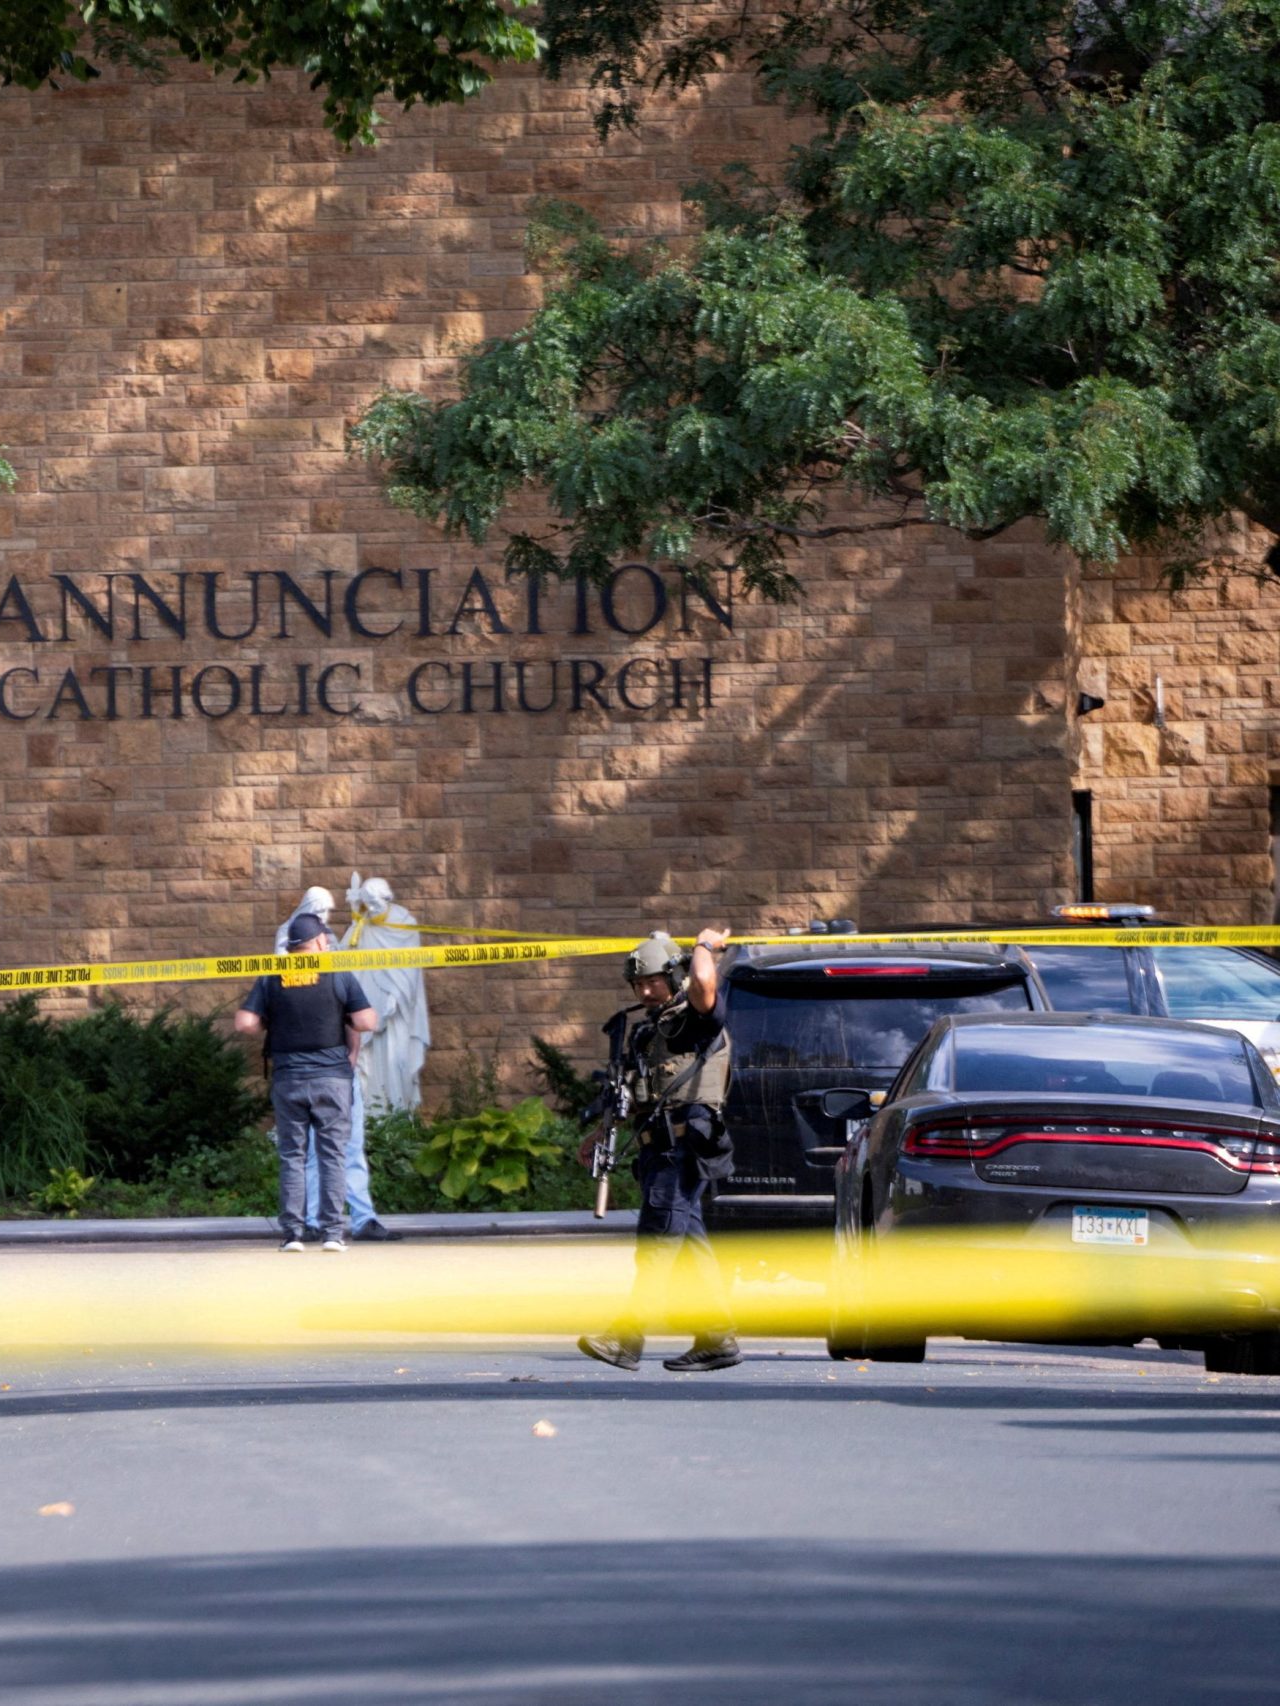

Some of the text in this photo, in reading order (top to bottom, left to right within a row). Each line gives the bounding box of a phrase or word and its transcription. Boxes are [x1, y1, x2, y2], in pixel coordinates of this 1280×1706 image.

[407, 657, 716, 714] CHURCH
[444, 944, 547, 962] POLICE LINE DO NOT CROSS
[216, 955, 320, 974] POLICE LINE DO NOT CROSS
[15, 971, 31, 985] NOT
[33, 970, 43, 984] DO
[46, 969, 63, 983] LINE
[65, 968, 91, 982] POLICE
[727, 1176, 796, 1184] SUBURBAN
